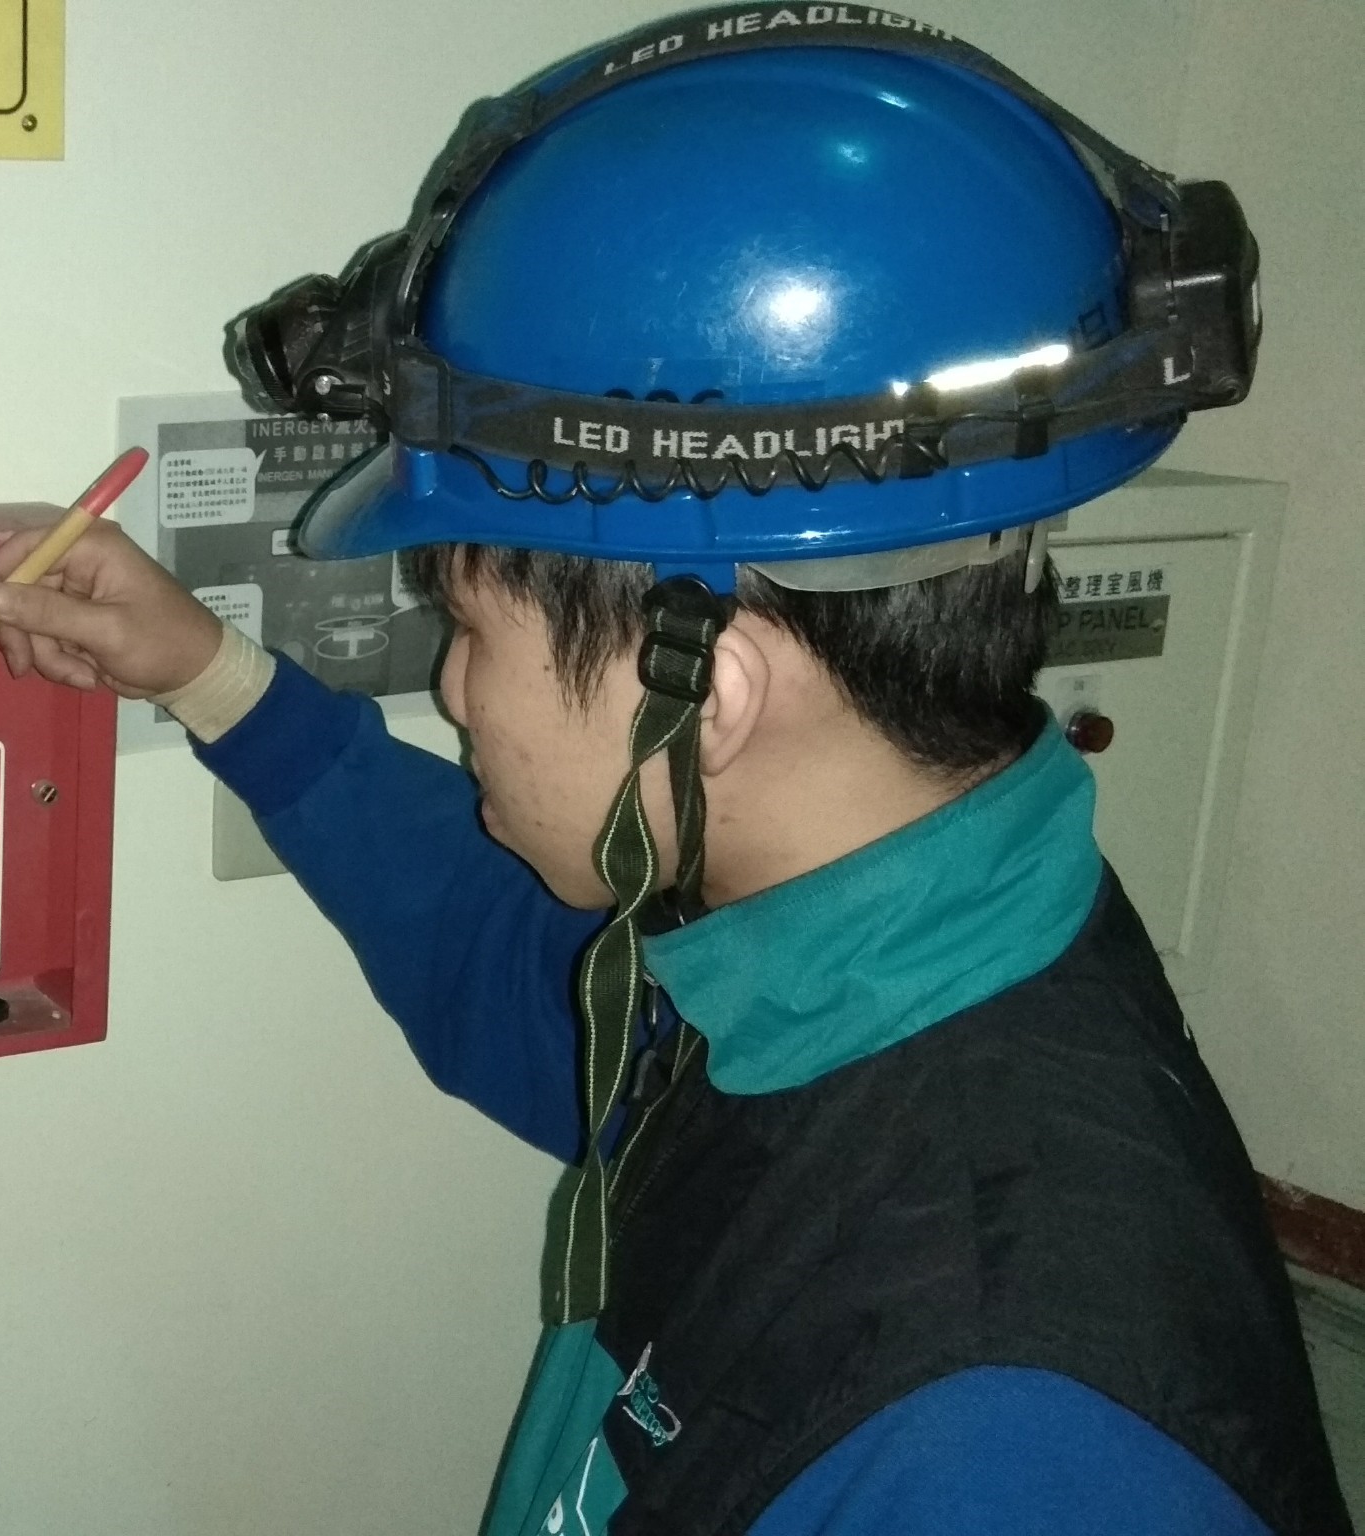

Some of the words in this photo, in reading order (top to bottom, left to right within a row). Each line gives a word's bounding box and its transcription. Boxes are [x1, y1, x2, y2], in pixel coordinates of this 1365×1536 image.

[604, 34, 684, 76] LED
[706, 5, 953, 42] HEADLIGH
[554, 416, 630, 453] LED
[256, 470, 303, 482] INERGEN
[1079, 605, 1150, 633] PANEL
